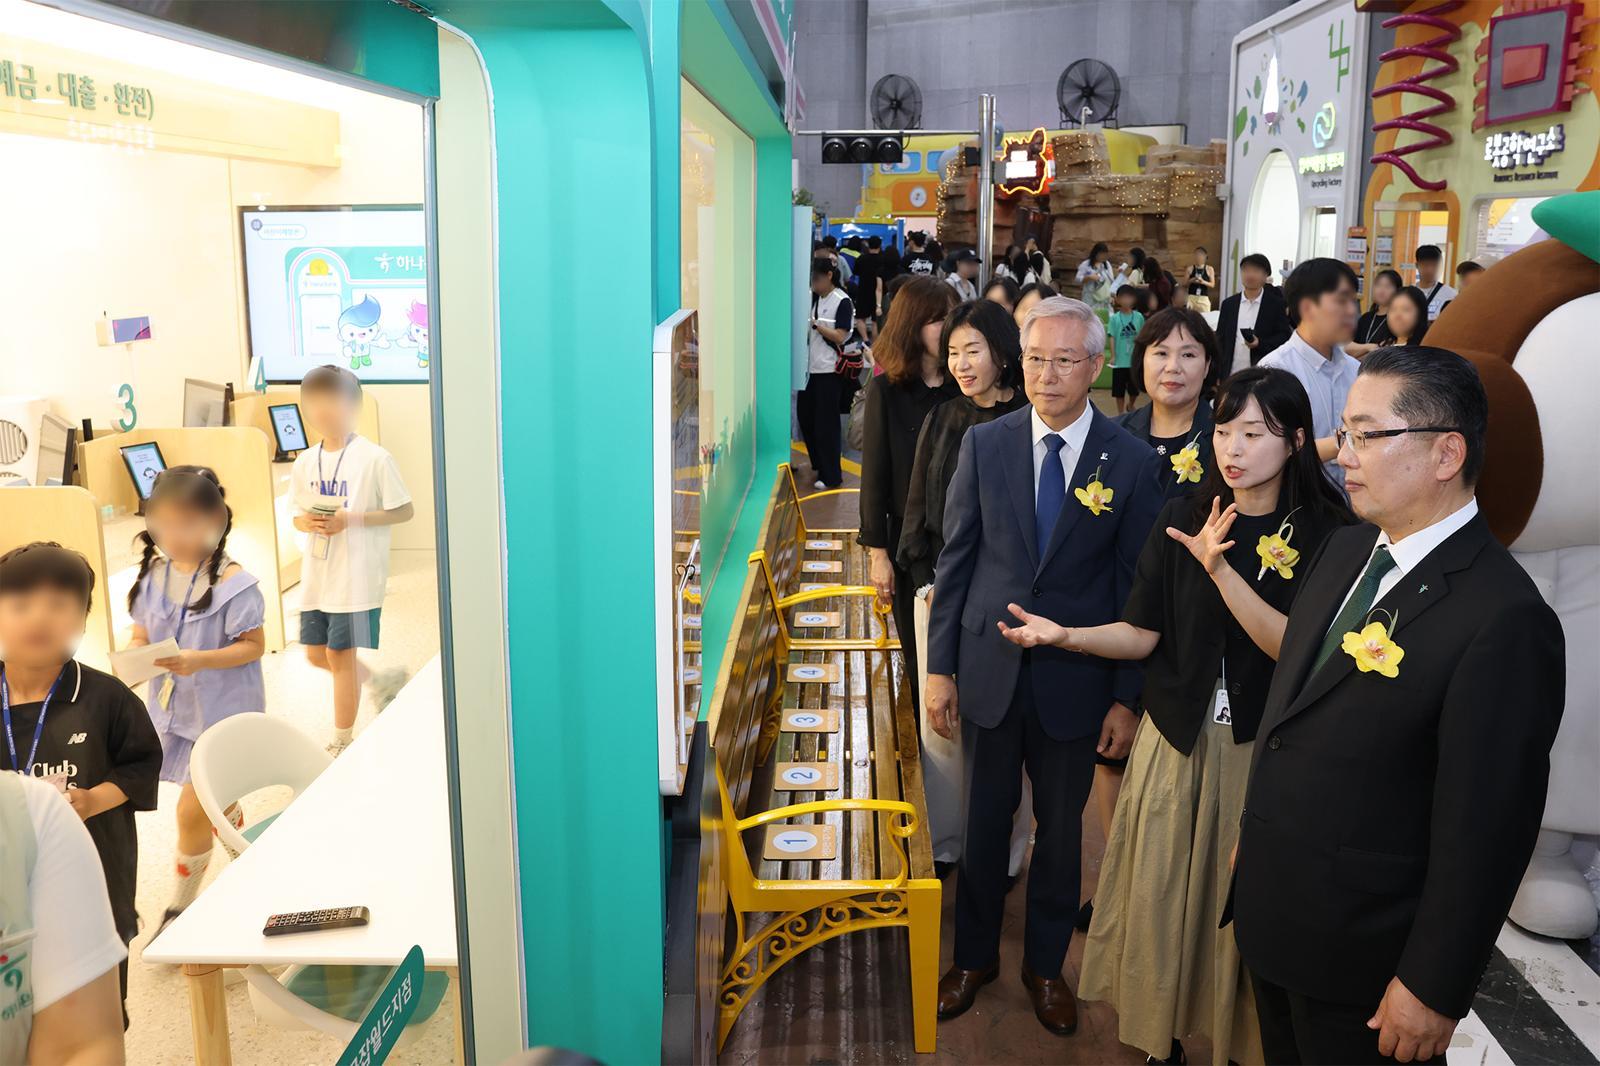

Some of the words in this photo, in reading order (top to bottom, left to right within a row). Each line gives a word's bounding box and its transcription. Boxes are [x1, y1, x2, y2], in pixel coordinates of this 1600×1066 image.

[254, 355, 269, 395] 4
[117, 383, 138, 433] 3
[800, 667, 819, 676] 4
[795, 715, 816, 725] 3
[31, 760, 78, 778] Club
[790, 771, 813, 780] 2
